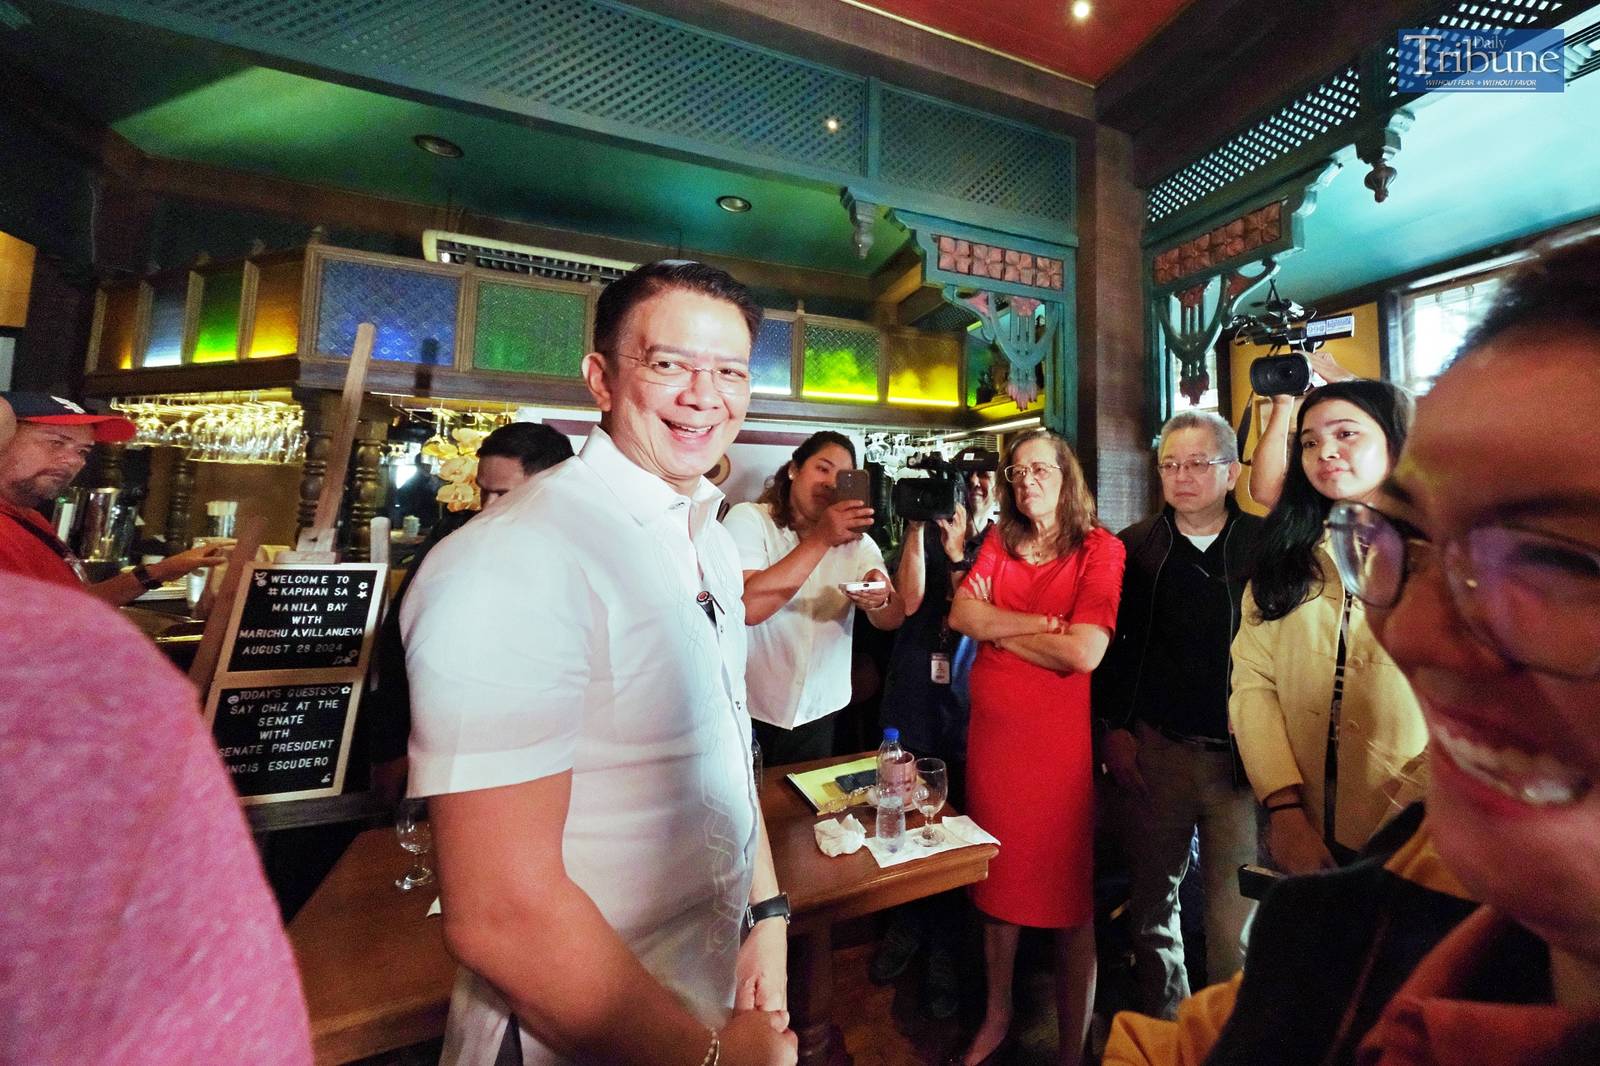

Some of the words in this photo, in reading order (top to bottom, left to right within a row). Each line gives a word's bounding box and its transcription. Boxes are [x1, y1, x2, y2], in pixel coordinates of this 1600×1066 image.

[271, 575, 329, 584] WELCOME
[337, 575, 350, 584] TO
[334, 587, 348, 596] SA
[272, 603, 317, 612] MANILA
[327, 602, 348, 612] BAY
[291, 615, 322, 624] WITH
[239, 629, 288, 638] MARICHU
[242, 644, 291, 655] AUGUST
[296, 644, 311, 653] 28
[314, 643, 343, 653] 2024
[287, 687, 327, 698] GUESTS
[230, 704, 255, 715] SAY
[262, 702, 288, 713] CHIZ
[296, 701, 311, 711] AT
[317, 700, 340, 709] THE
[257, 714, 305, 727] SENATE
[260, 729, 290, 739] WITH
[218, 745, 264, 757] SENATE
[272, 739, 335, 753] PRESIDENT
[268, 756, 329, 771] ESCUDERO
